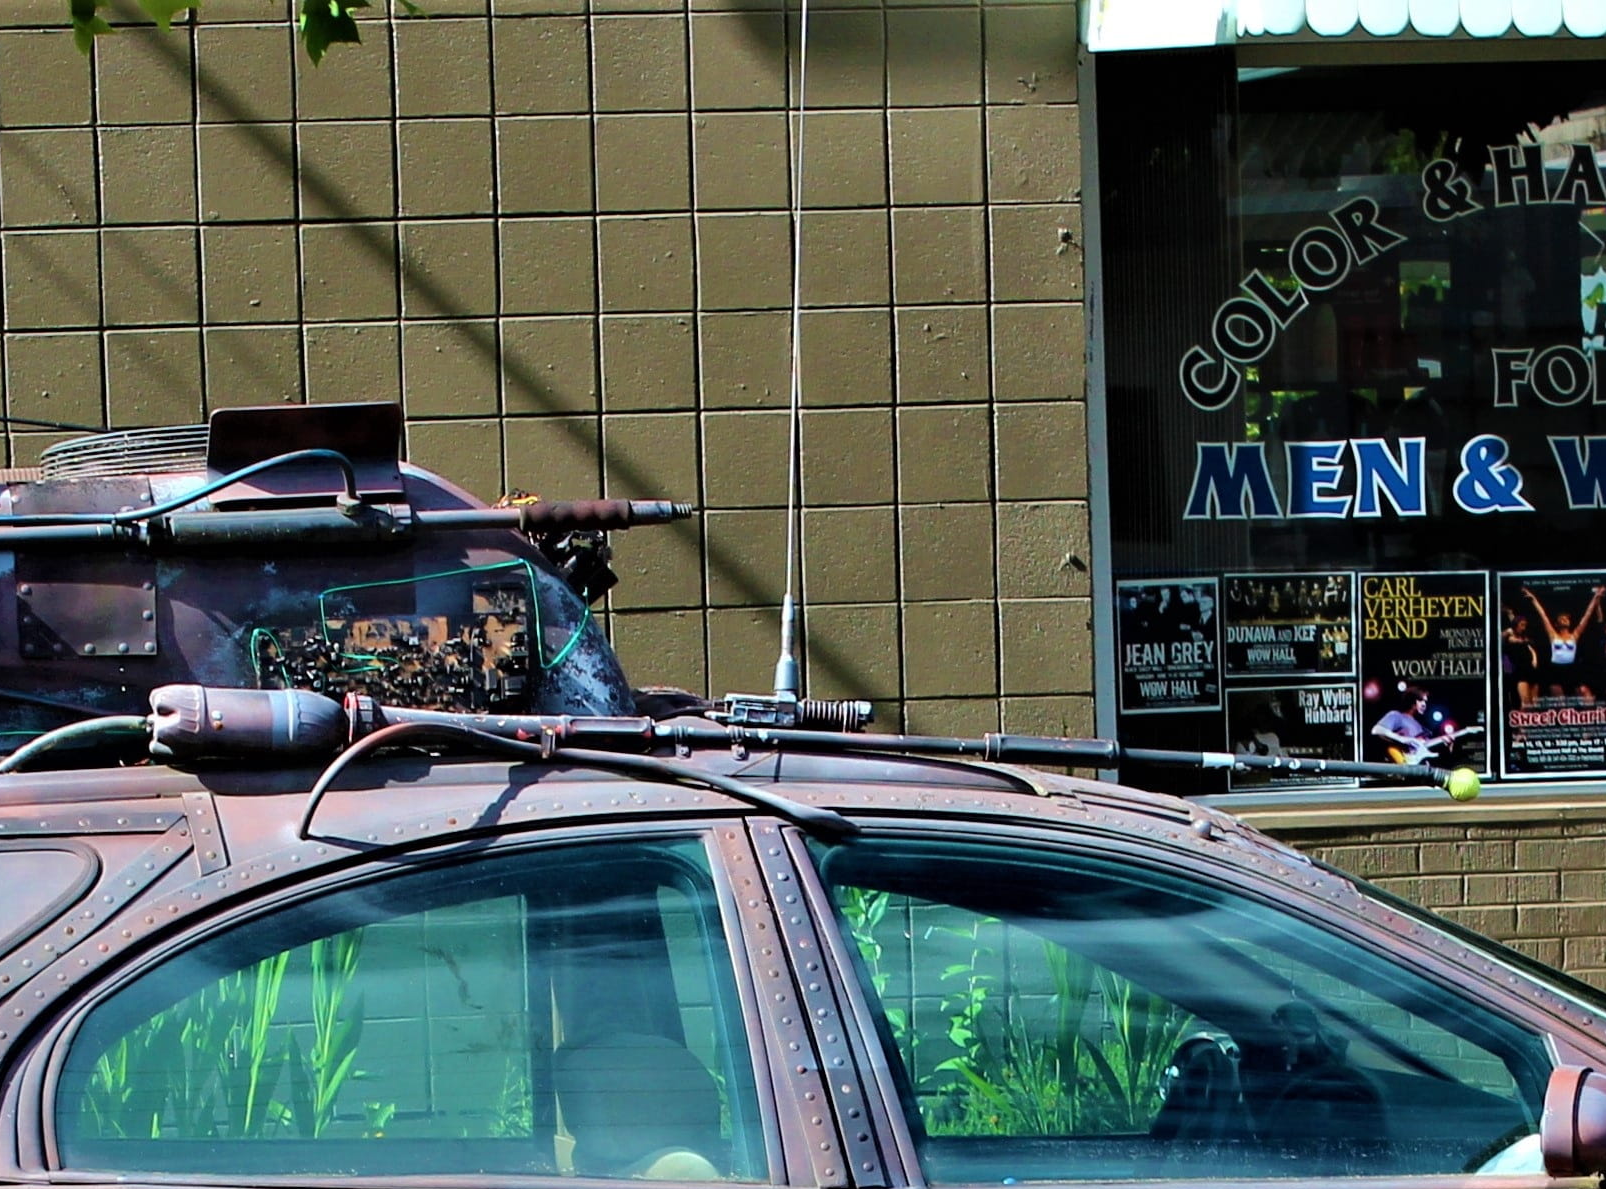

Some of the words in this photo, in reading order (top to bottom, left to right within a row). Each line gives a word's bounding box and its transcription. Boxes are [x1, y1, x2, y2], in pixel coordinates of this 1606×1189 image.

[1179, 195, 1407, 412] COLOR
[1420, 157, 1485, 223] &
[1183, 435, 1427, 520] MEN
[1452, 433, 1536, 514] &
[1363, 577, 1422, 598] CARL
[1363, 595, 1484, 618] VERHEYEN
[1227, 626, 1275, 643] DUNAVA
[1364, 618, 1428, 639] BAND
[1124, 643, 1165, 666] JEAN
[1171, 641, 1214, 664] GREY
[1247, 648, 1271, 661] WOW
[1273, 647, 1296, 661] HALL
[1392, 660, 1437, 676] WOW
[1441, 659, 1484, 676] HALL
[1139, 681, 1168, 697] WOW
[1171, 680, 1200, 696] HALL
[1298, 690, 1319, 710] Ray
[1322, 688, 1352, 709] Wylie
[1304, 706, 1353, 724] Hubbard
[1509, 708, 1557, 727] Sweet
